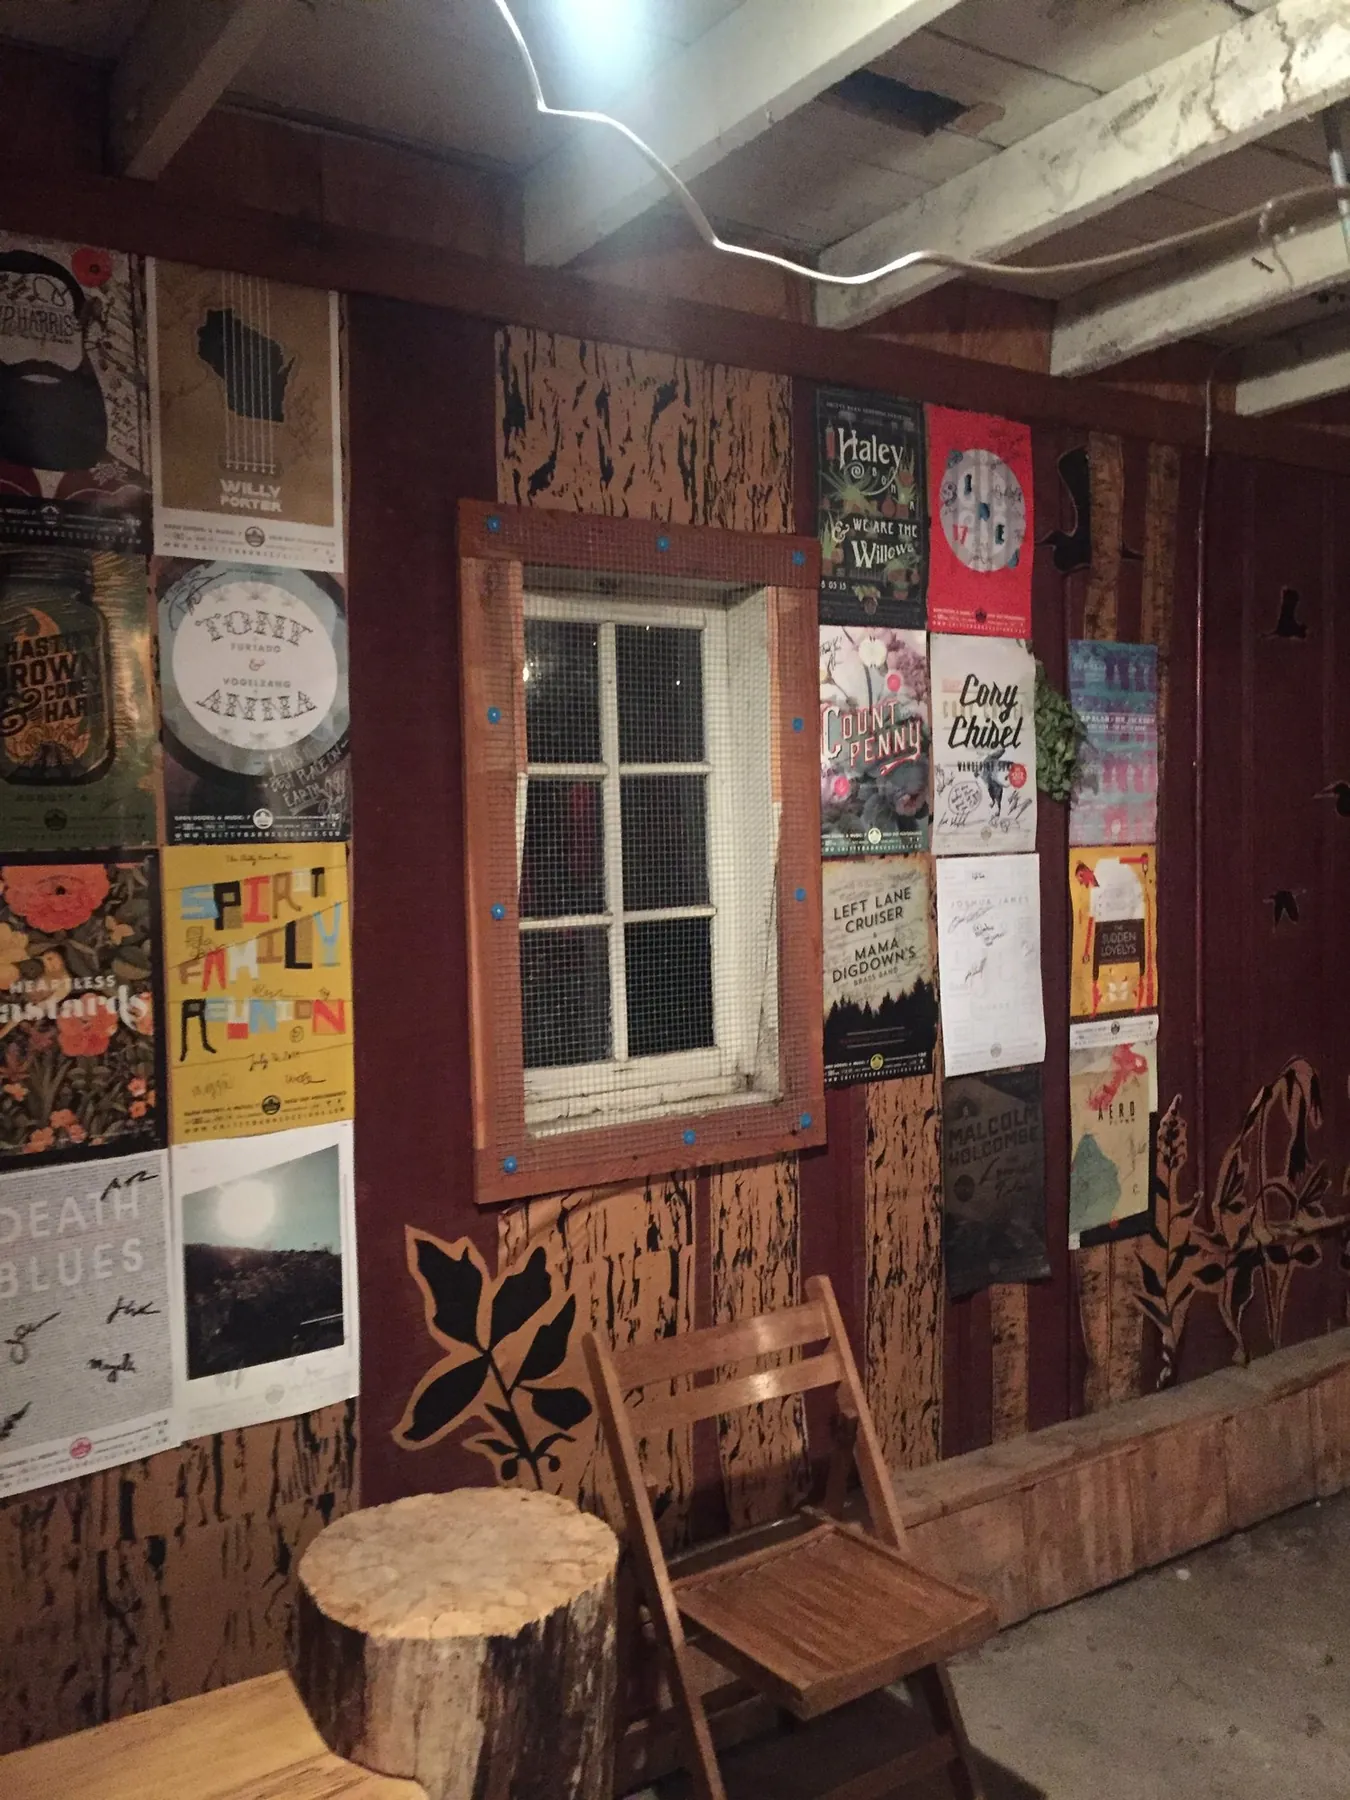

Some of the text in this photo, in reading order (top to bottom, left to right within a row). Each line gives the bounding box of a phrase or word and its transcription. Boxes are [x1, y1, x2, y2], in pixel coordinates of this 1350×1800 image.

[838, 427, 904, 470] Haley
[219, 478, 281, 499] WILLY
[220, 495, 283, 512] PORTER
[831, 520, 850, 543] &
[852, 518, 918, 538] WE ARE THE
[195, 610, 314, 647] TONY
[195, 689, 318, 721] ANNA
[959, 673, 1018, 724] Cory
[820, 699, 897, 762] COUNT
[850, 719, 921, 777] PENNY
[948, 715, 1023, 750] Chisel
[282, 783, 322, 807] EARTH
[180, 866, 326, 931] SPIRIT
[833, 886, 912, 921] LEFT LANE
[845, 906, 904, 933] CRUISER
[178, 901, 342, 993] FAMILY
[832, 946, 917, 984] DIGDOWN'S
[855, 937, 900, 961] MAMA
[179, 998, 346, 1063] REUNION
[949, 1102, 1038, 1148] MALCOLM
[0, 1183, 139, 1244] DEATH
[0, 1238, 143, 1300] BLUES
